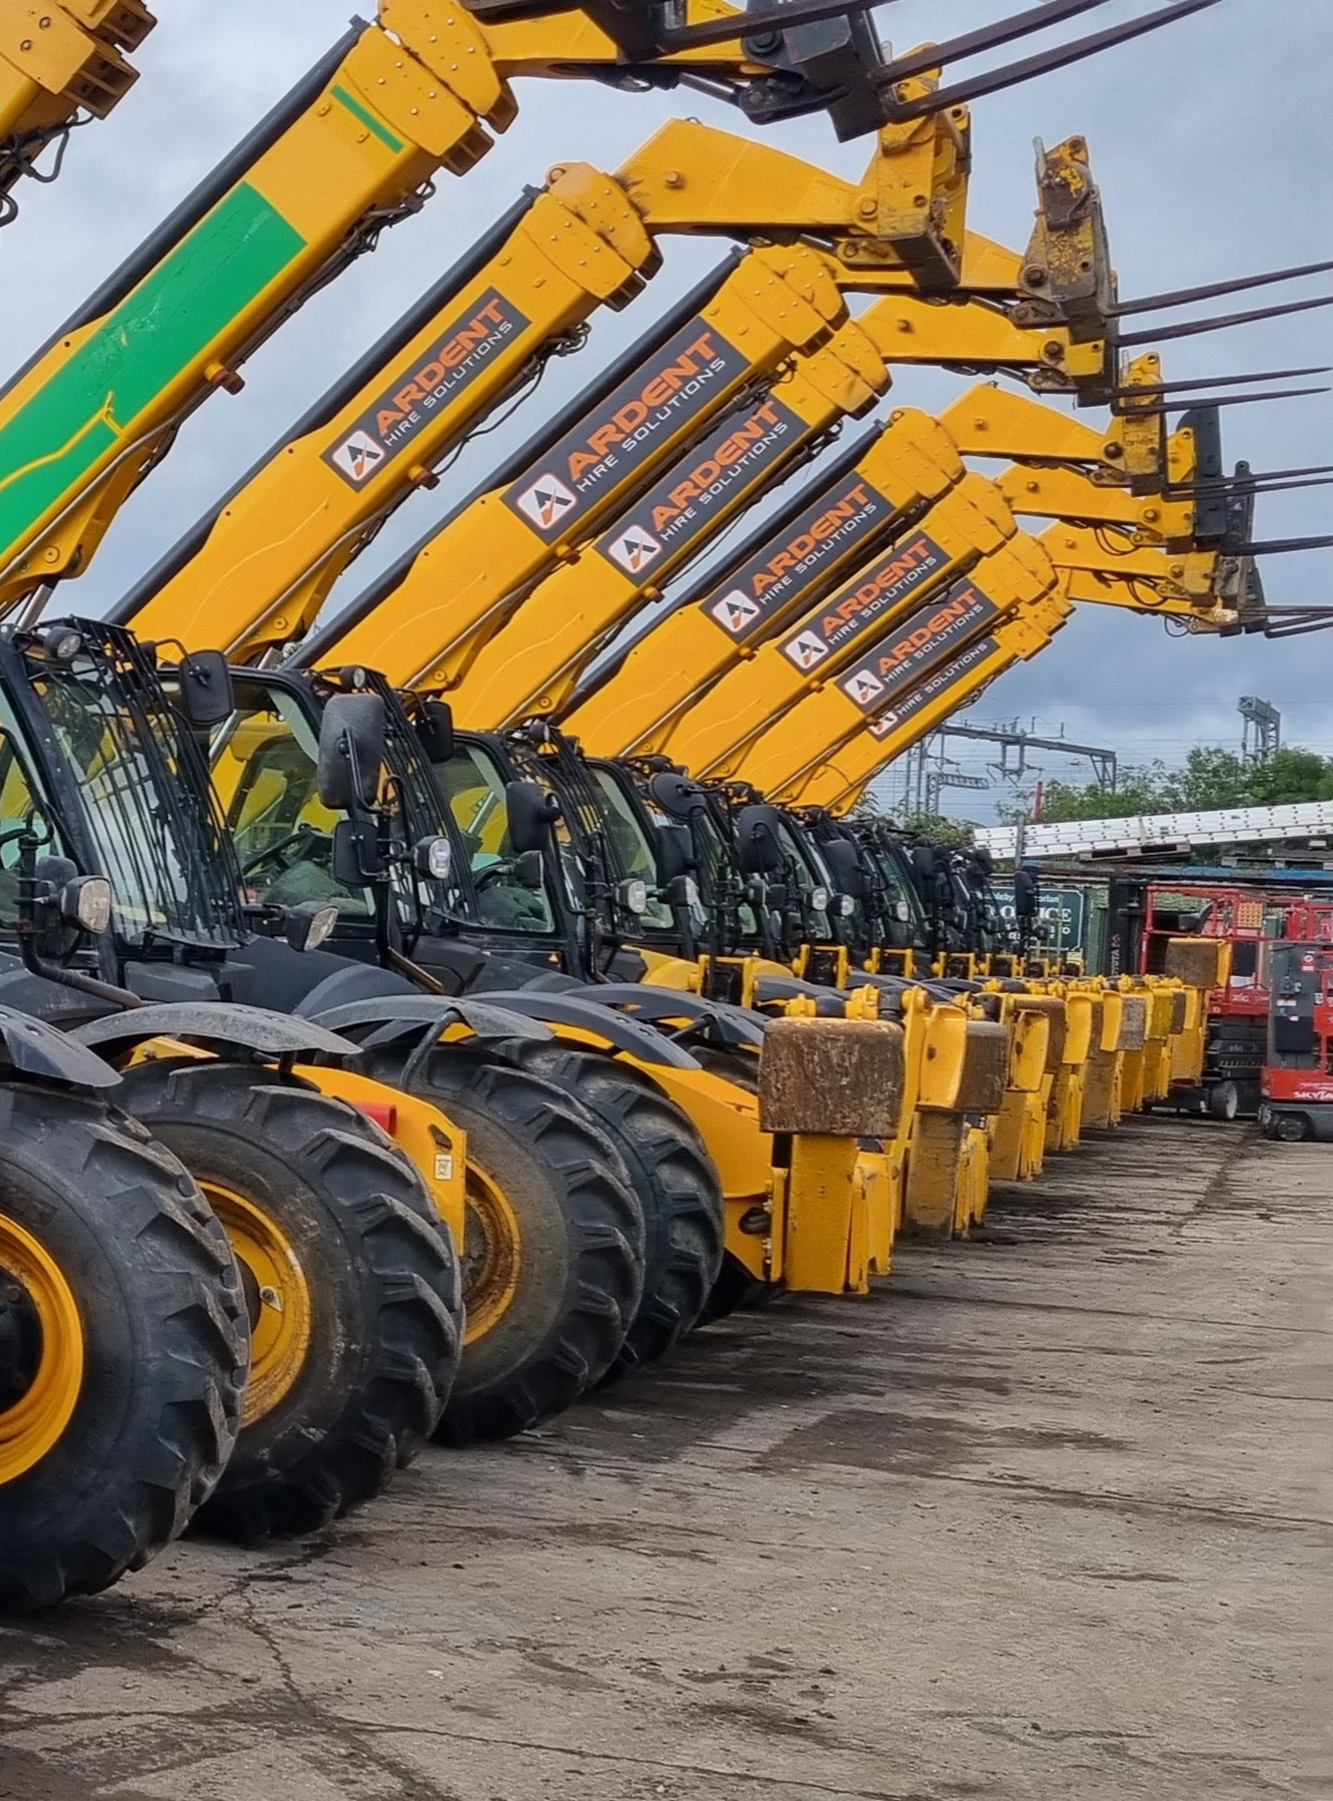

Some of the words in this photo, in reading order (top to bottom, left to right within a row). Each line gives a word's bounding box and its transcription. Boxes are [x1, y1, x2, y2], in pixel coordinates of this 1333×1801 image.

[375, 298, 504, 437] ARDENT
[384, 411, 422, 447] HIRE
[423, 320, 513, 409] SOLUTIONS
[568, 331, 717, 481] ARDENT
[576, 454, 620, 493] HIRE
[621, 357, 726, 452] SOLUTIONS
[651, 400, 779, 532] ARDENT
[660, 507, 698, 541] HIRE
[699, 422, 788, 504] SOLUTIONS
[752, 483, 869, 596] ARDENT
[759, 575, 793, 605] HIRE
[794, 503, 877, 574] SOLUTIONS
[822, 538, 930, 637] ARDENT
[828, 619, 860, 645] HIRE
[861, 556, 937, 618] SOLUTIONS
[878, 588, 977, 675] ARDENT
[883, 661, 913, 683] HIRE
[914, 604, 983, 659] SOLUTIONS
[897, 693, 923, 716] HIRE
[925, 643, 988, 693] SOLUTIONS
